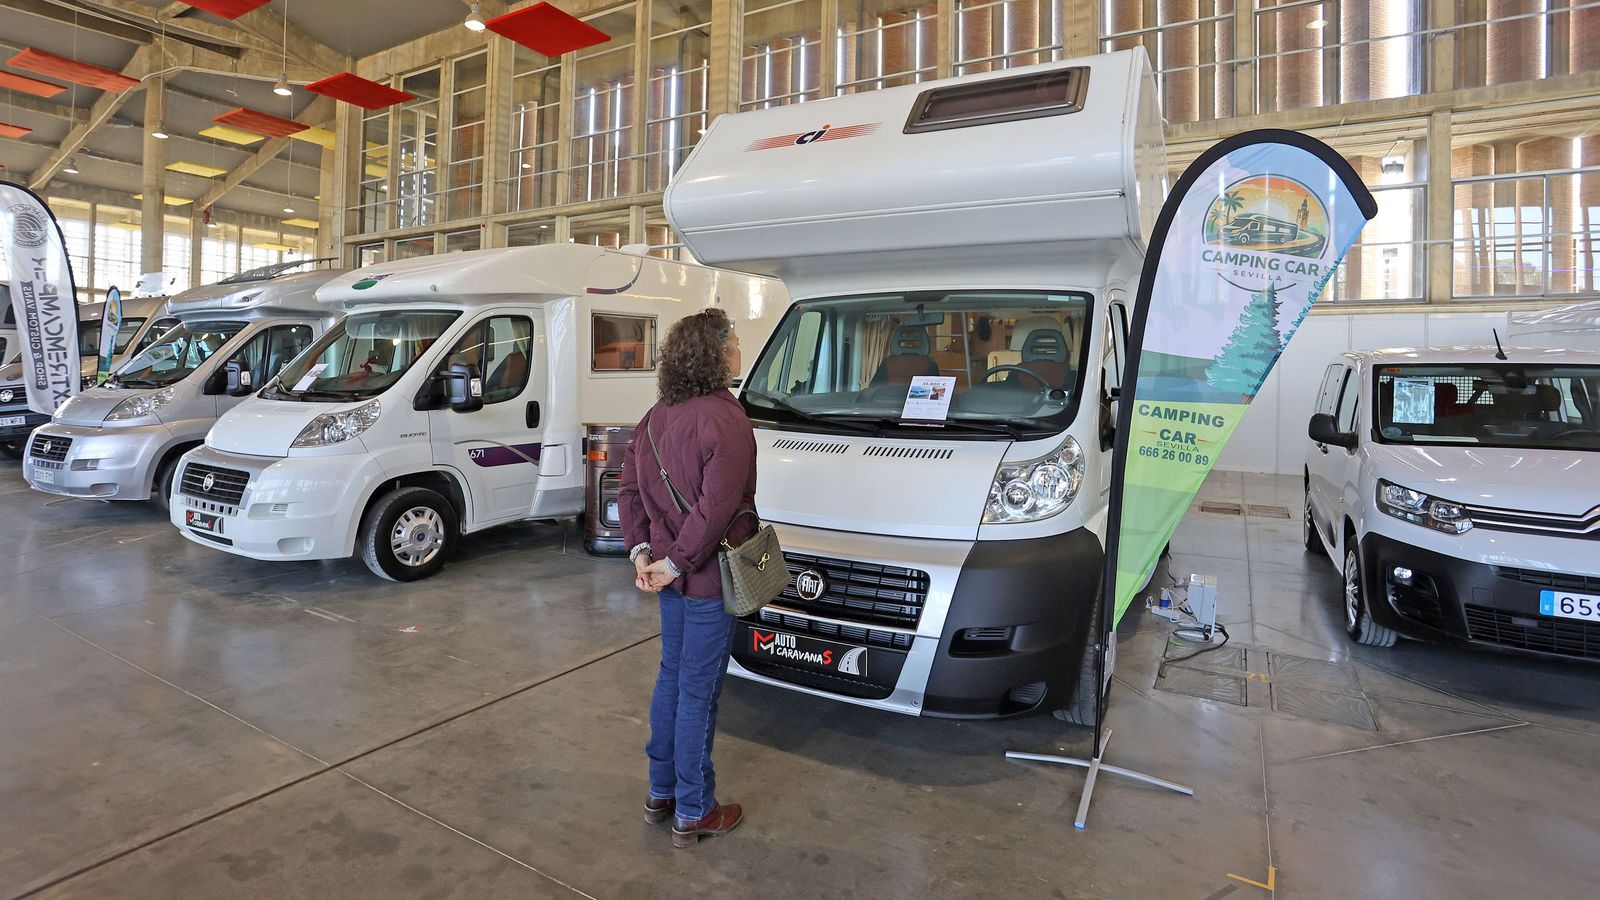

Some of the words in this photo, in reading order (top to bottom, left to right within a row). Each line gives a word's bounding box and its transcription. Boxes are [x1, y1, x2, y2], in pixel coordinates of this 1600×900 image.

[1201, 249, 1280, 271] CAMPING
[1284, 260, 1320, 276] CAR
[1233, 269, 1282, 282] SEVILLA
[1138, 404, 1225, 428] CAMPING
[1159, 428, 1197, 445] CAR
[470, 449, 485, 459] 671
[1139, 445, 1159, 458] 666
[1162, 449, 1176, 461] 26
[1178, 451, 1192, 463] 00
[1195, 454, 1209, 466] 89
[1156, 440, 1200, 453] SEVILLA
[801, 575, 819, 594] FIAT
[1560, 596, 1600, 617] 65
[775, 633, 796, 649] AUTO
